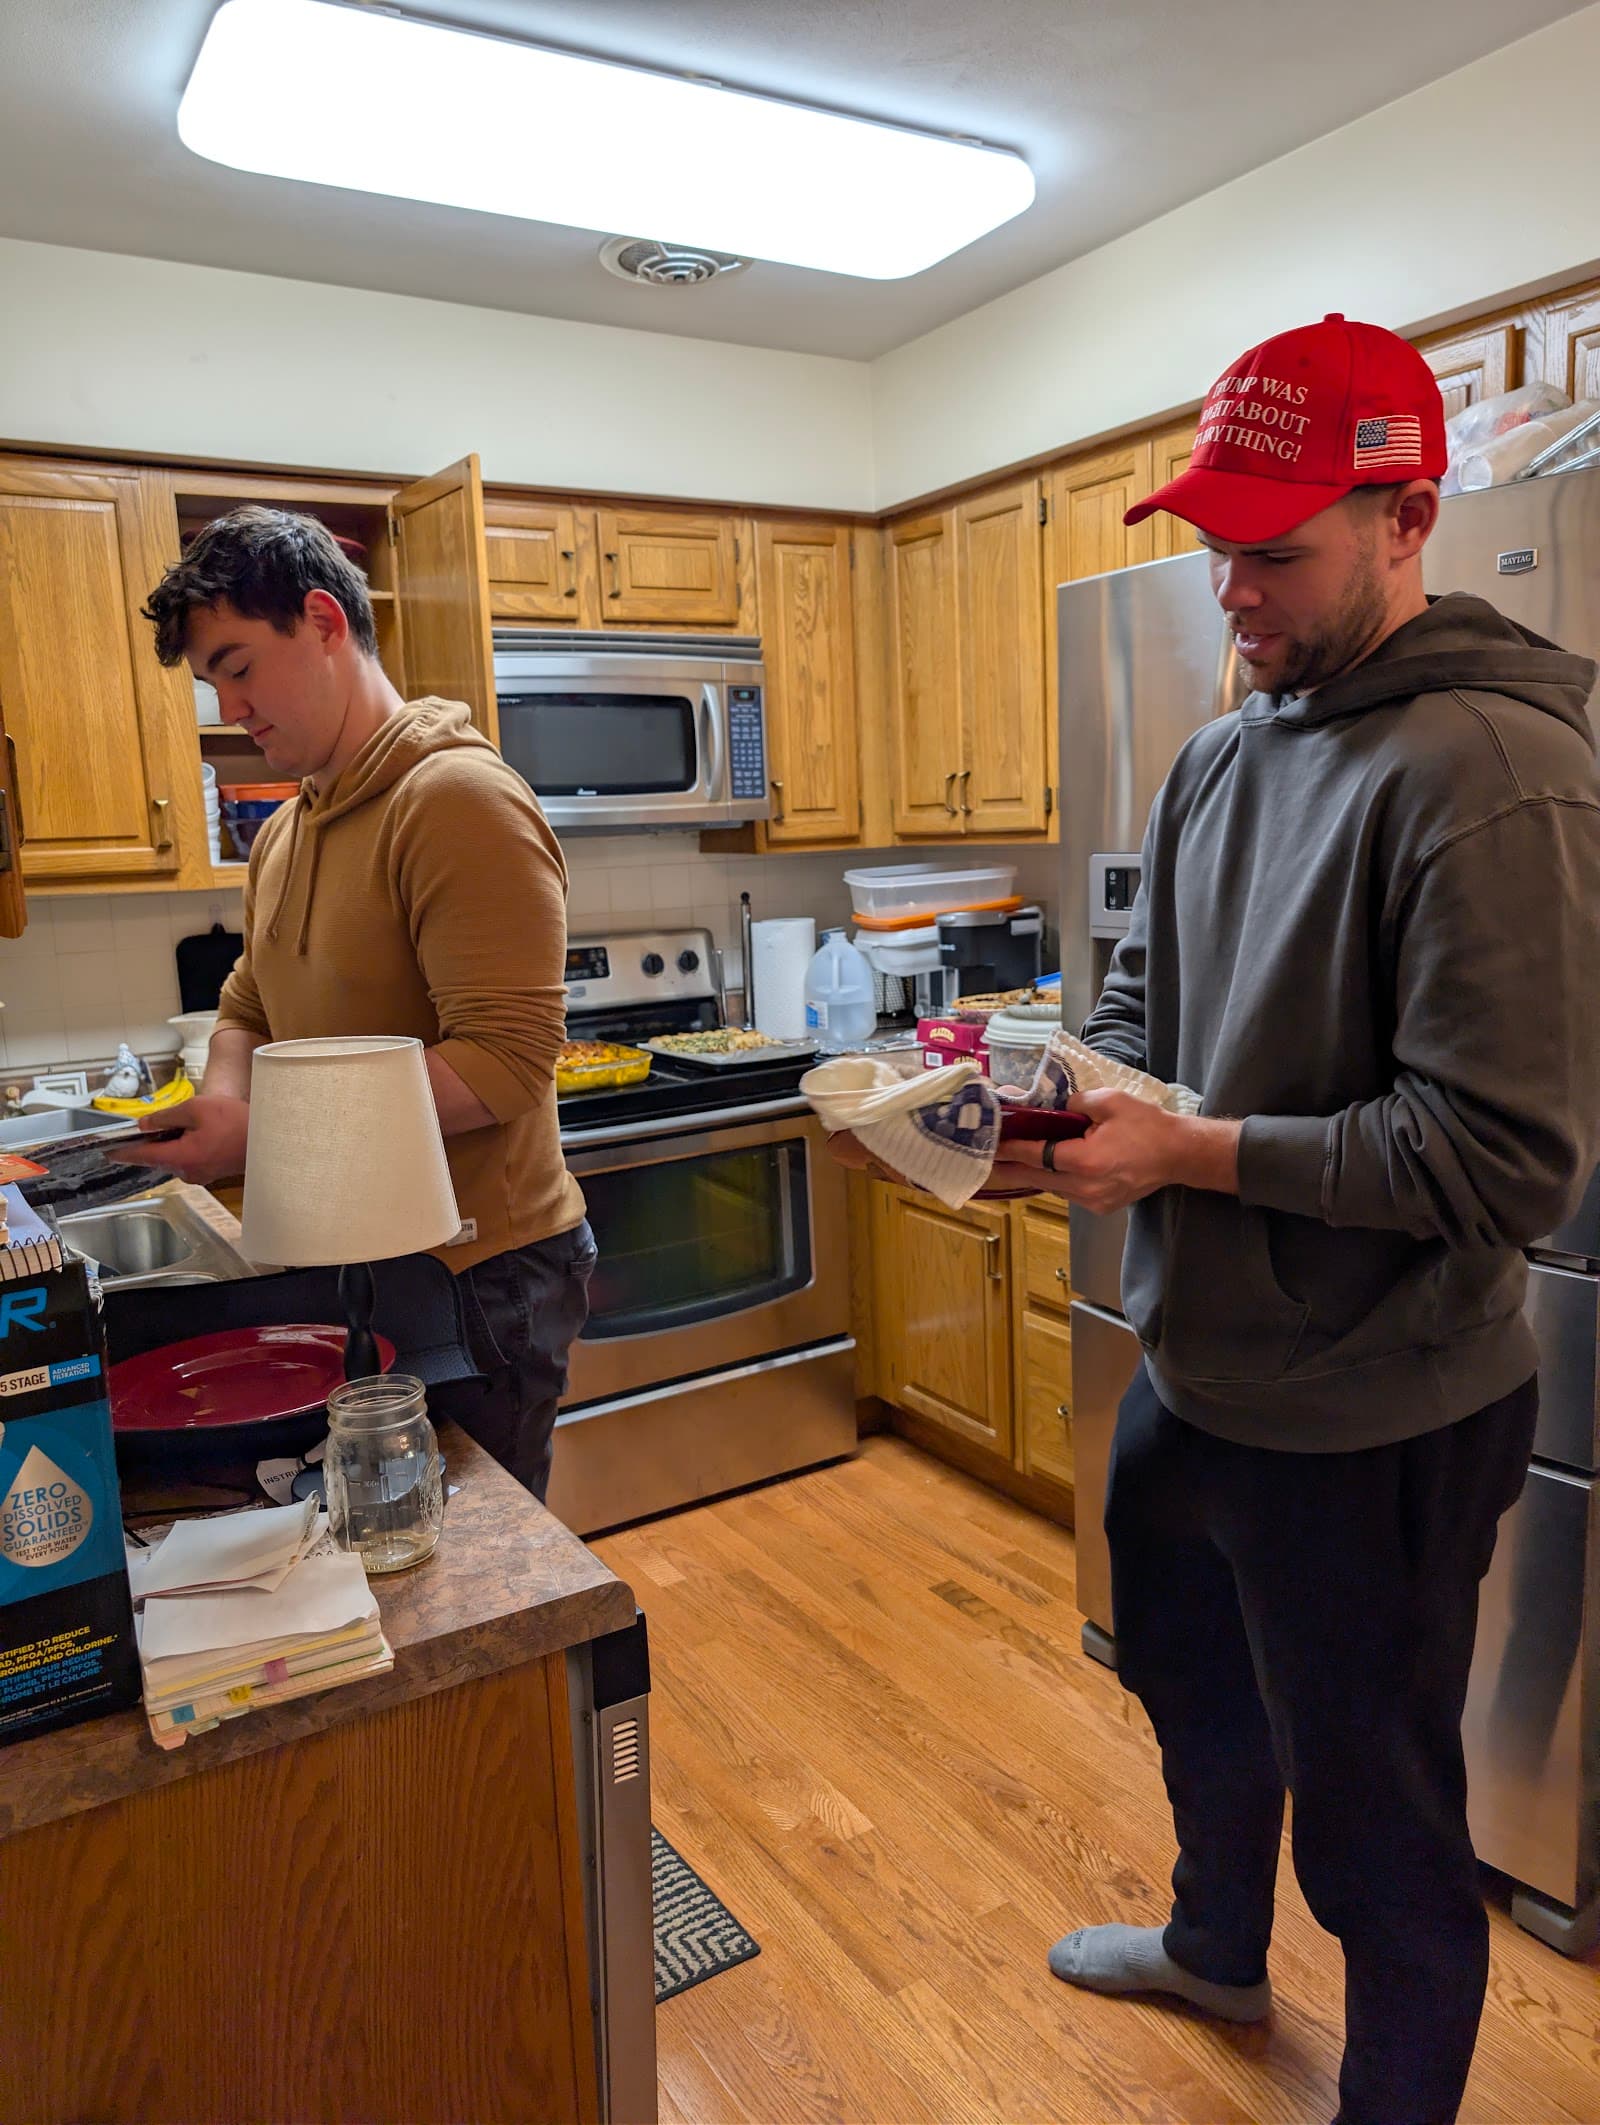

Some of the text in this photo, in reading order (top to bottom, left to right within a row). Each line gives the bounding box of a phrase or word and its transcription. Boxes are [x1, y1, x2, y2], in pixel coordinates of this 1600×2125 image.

[1262, 376, 1309, 405] WAS
[1231, 400, 1311, 436] ABOUT
[1500, 554, 1532, 567] MAYTAG
[0, 1372, 47, 1393] 5 STAGE
[11, 1482, 67, 1510] ZERO
[3, 1495, 82, 1524] DISSOLVED
[3, 1507, 82, 1542] SOLIDS
[15, 1535, 77, 1559] TEST YOUR WATER
[25, 1550, 48, 1561] EVERY
[36, 1638, 51, 1649] TO
[52, 1625, 91, 1645] REDUCE
[42, 1651, 64, 1665] AND
